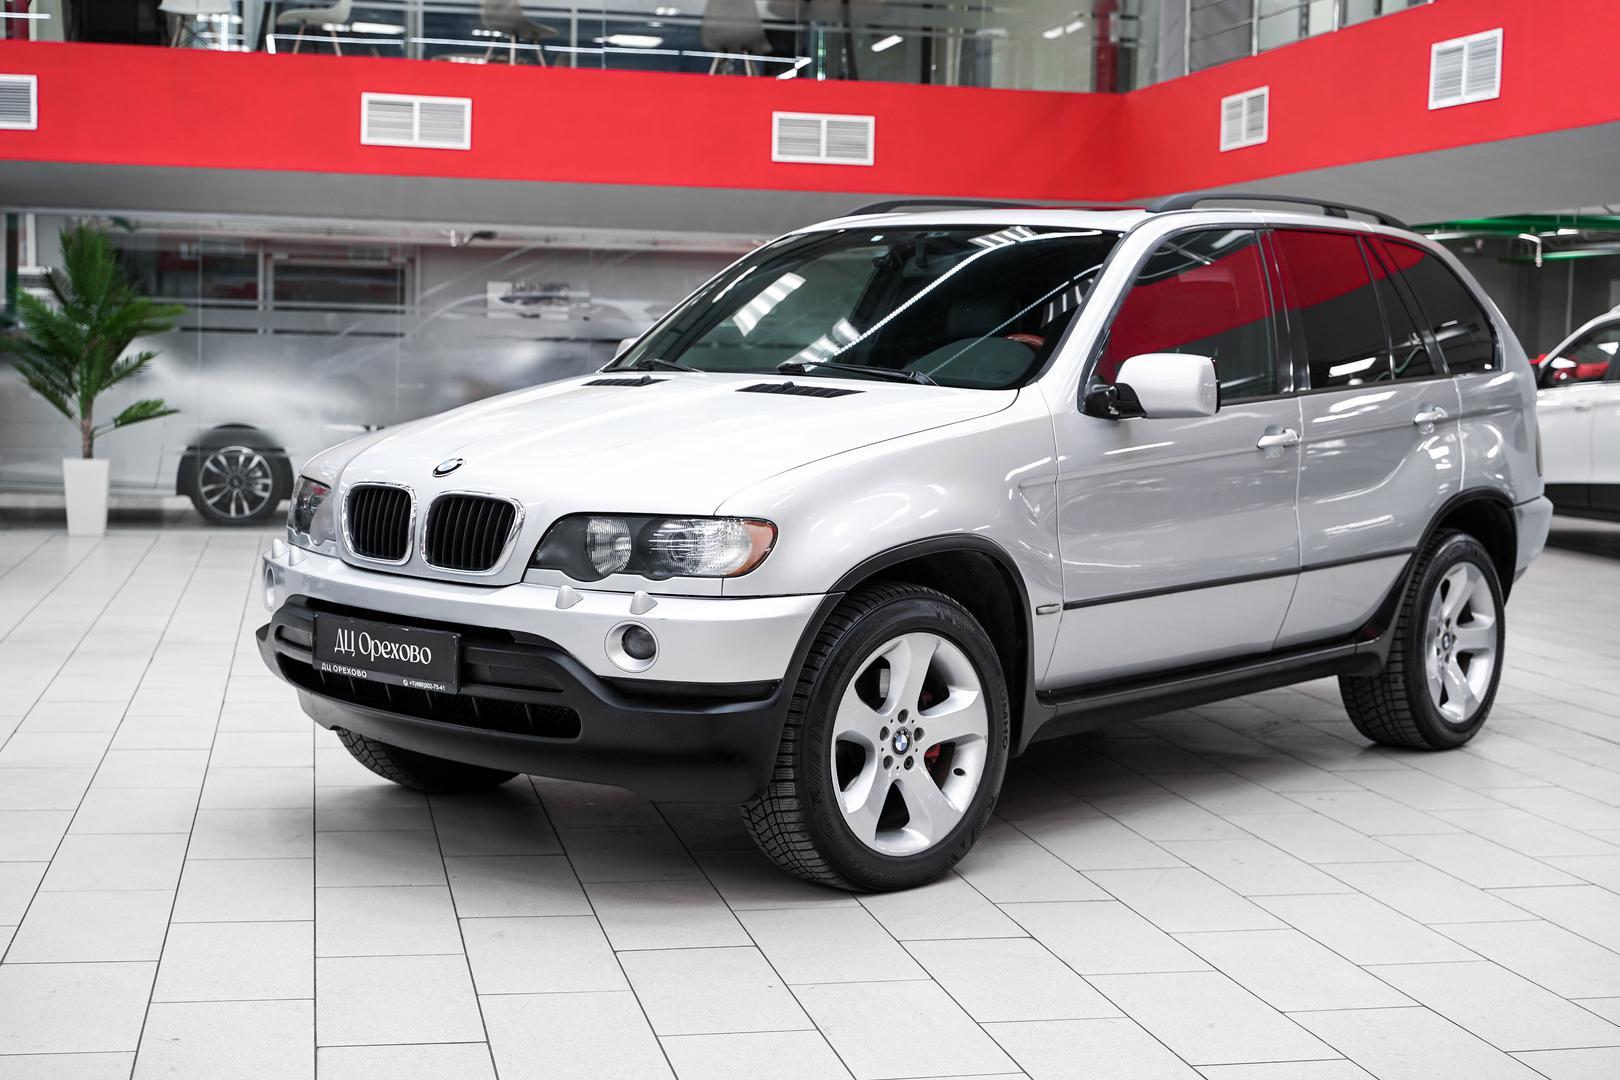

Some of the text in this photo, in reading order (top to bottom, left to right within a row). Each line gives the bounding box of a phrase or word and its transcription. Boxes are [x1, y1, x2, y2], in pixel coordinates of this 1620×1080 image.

[335, 628, 432, 664] ДЦ Орехово
[322, 662, 367, 678] ДЦ ОРЕХОВО
